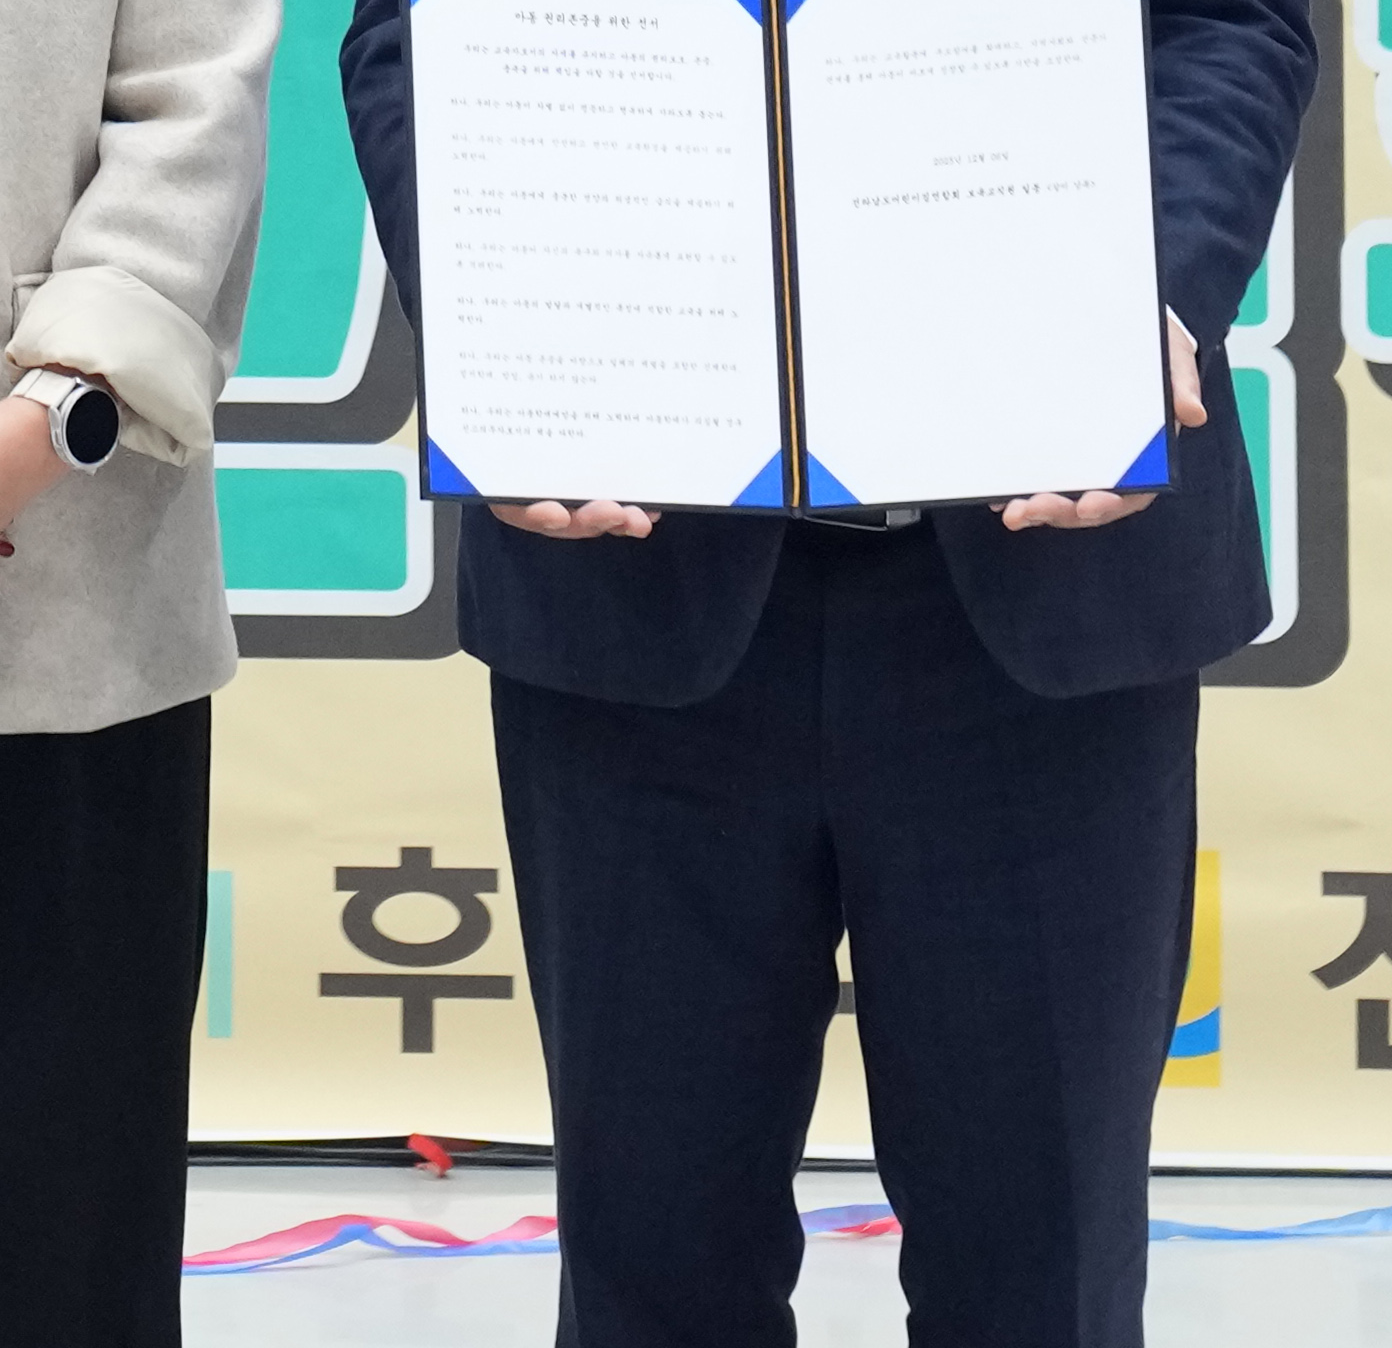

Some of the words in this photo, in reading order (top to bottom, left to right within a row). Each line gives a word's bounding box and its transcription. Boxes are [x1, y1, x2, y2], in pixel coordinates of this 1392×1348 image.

[514, 9, 538, 26] 아동
[543, 11, 602, 29] 권리존중을
[608, 14, 632, 31] 위한
[638, 16, 660, 31] 선서
